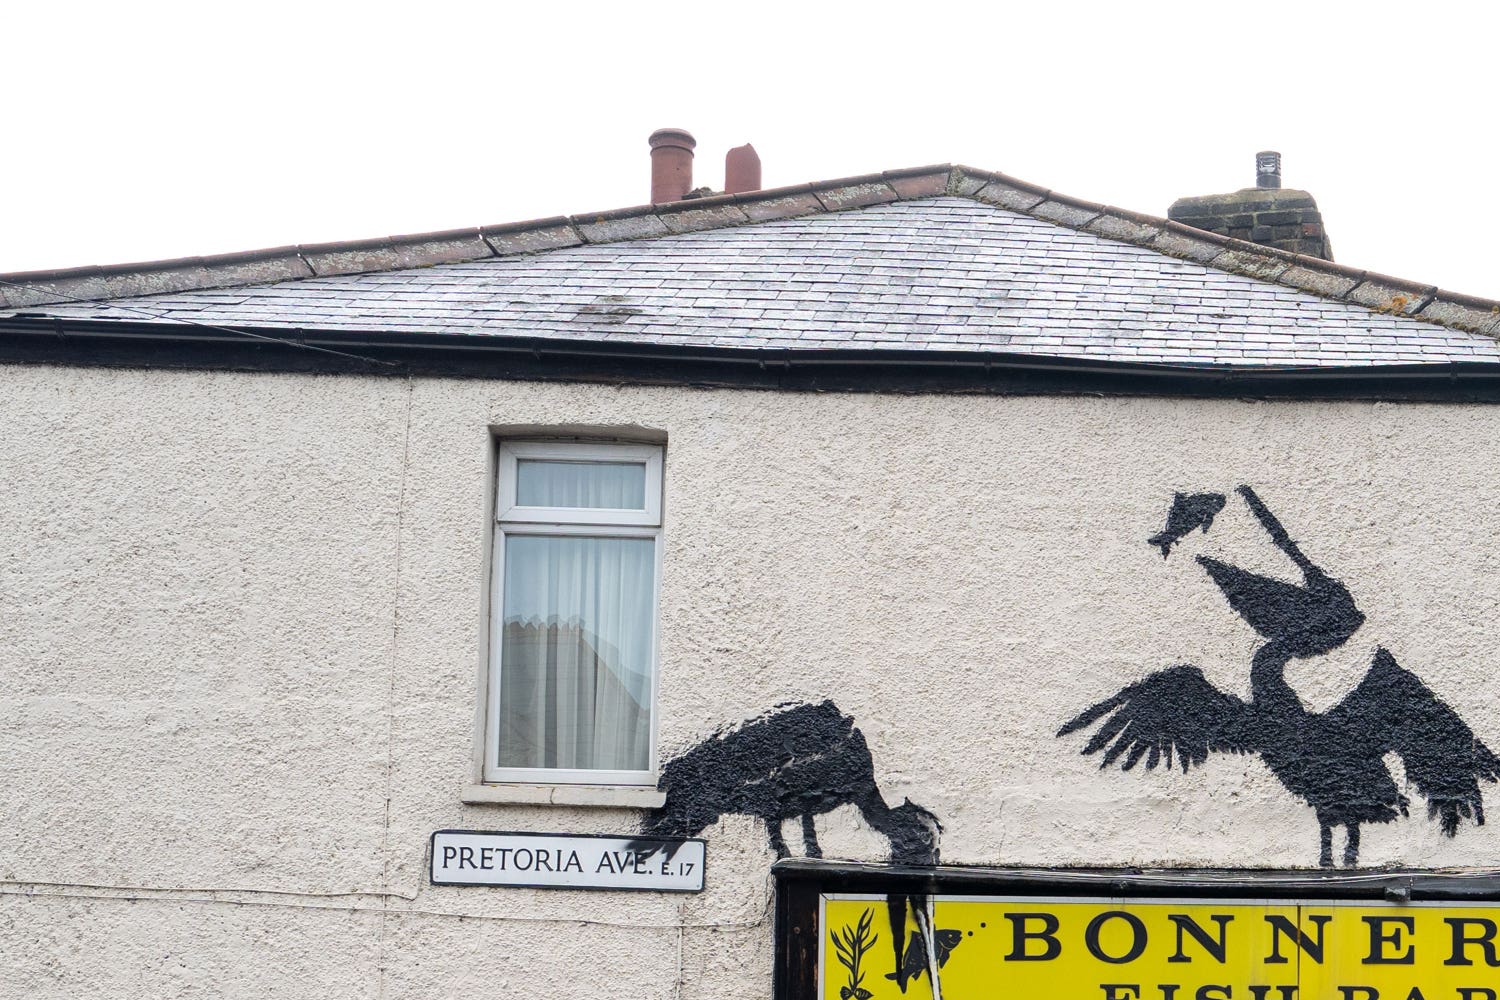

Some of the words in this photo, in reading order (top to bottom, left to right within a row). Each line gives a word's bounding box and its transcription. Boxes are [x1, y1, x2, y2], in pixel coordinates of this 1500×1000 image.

[442, 846, 584, 873] PRETORIA
[595, 850, 653, 875] AVE.
[661, 861, 674, 876] E.
[679, 862, 695, 876] 17
